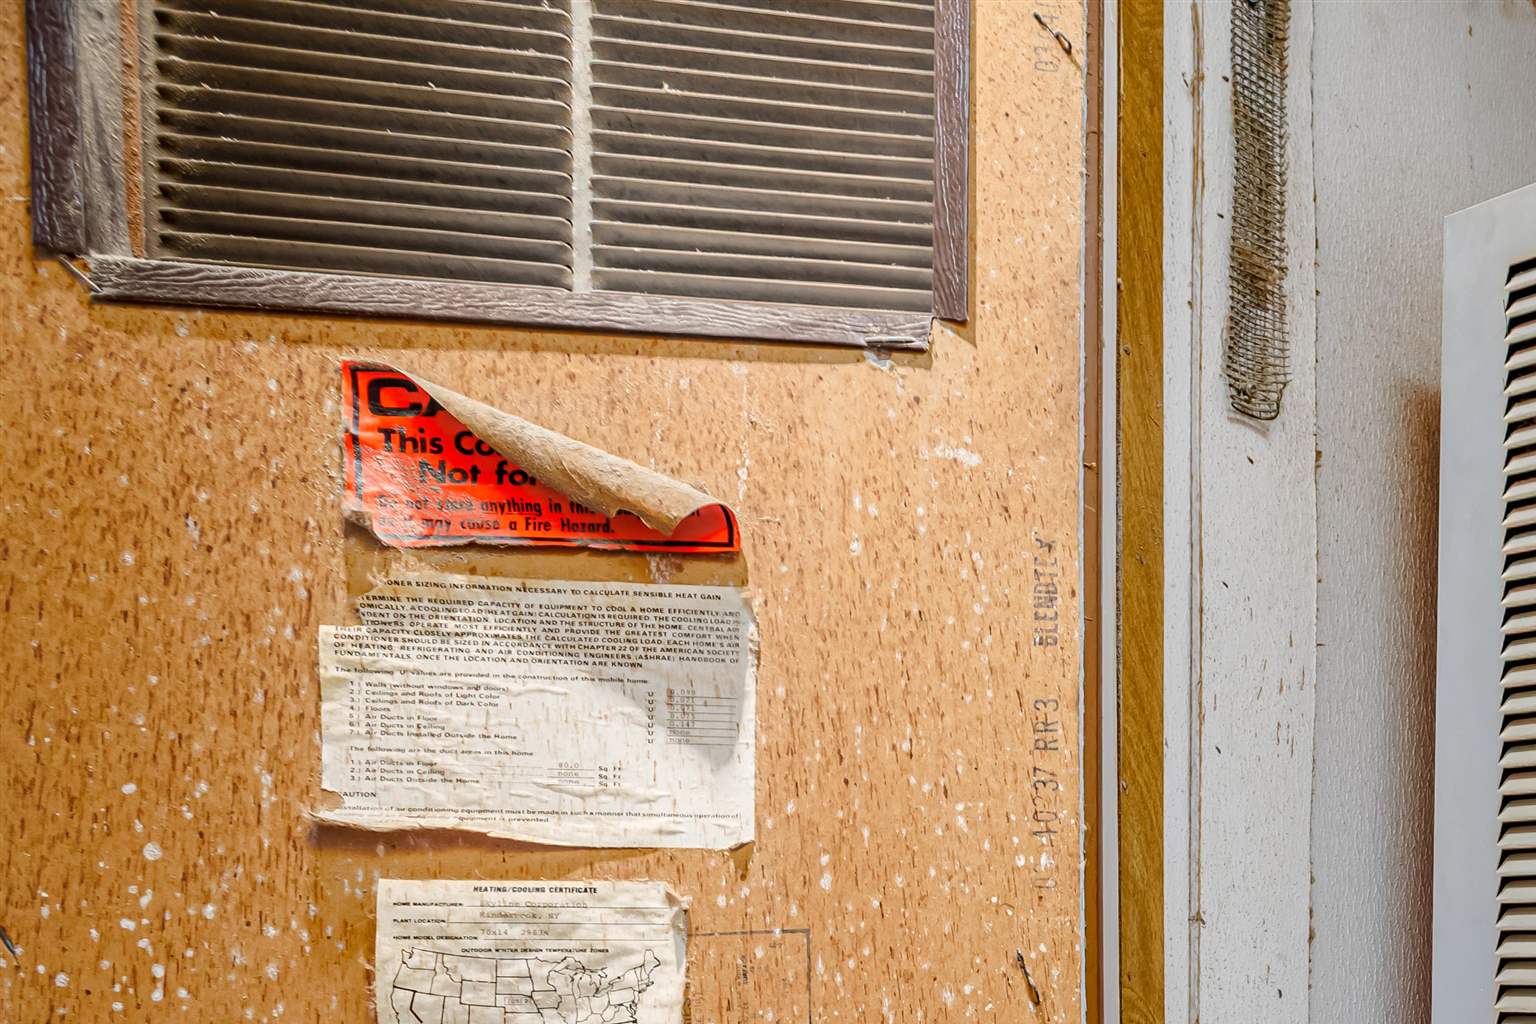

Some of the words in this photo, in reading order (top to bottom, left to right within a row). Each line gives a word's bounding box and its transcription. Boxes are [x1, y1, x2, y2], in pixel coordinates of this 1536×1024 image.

[378, 427, 443, 454] This
[455, 430, 496, 456] Co
[419, 460, 480, 485] Not
[496, 460, 536, 485] fo
[480, 497, 541, 517] anything
[569, 500, 591, 515] thi
[561, 518, 615, 534] Hazard.
[415, 581, 448, 589] SIZING
[449, 584, 513, 592] INFORMATION
[515, 586, 567, 594] NECESSARY
[427, 598, 475, 606] REQUIRED
[668, 608, 719, 616] EFFICIENTLY
[516, 650, 580, 658] CONDITIONING
[584, 652, 632, 660] ENGINEERS
[531, 658, 589, 666] ORIENTATION
